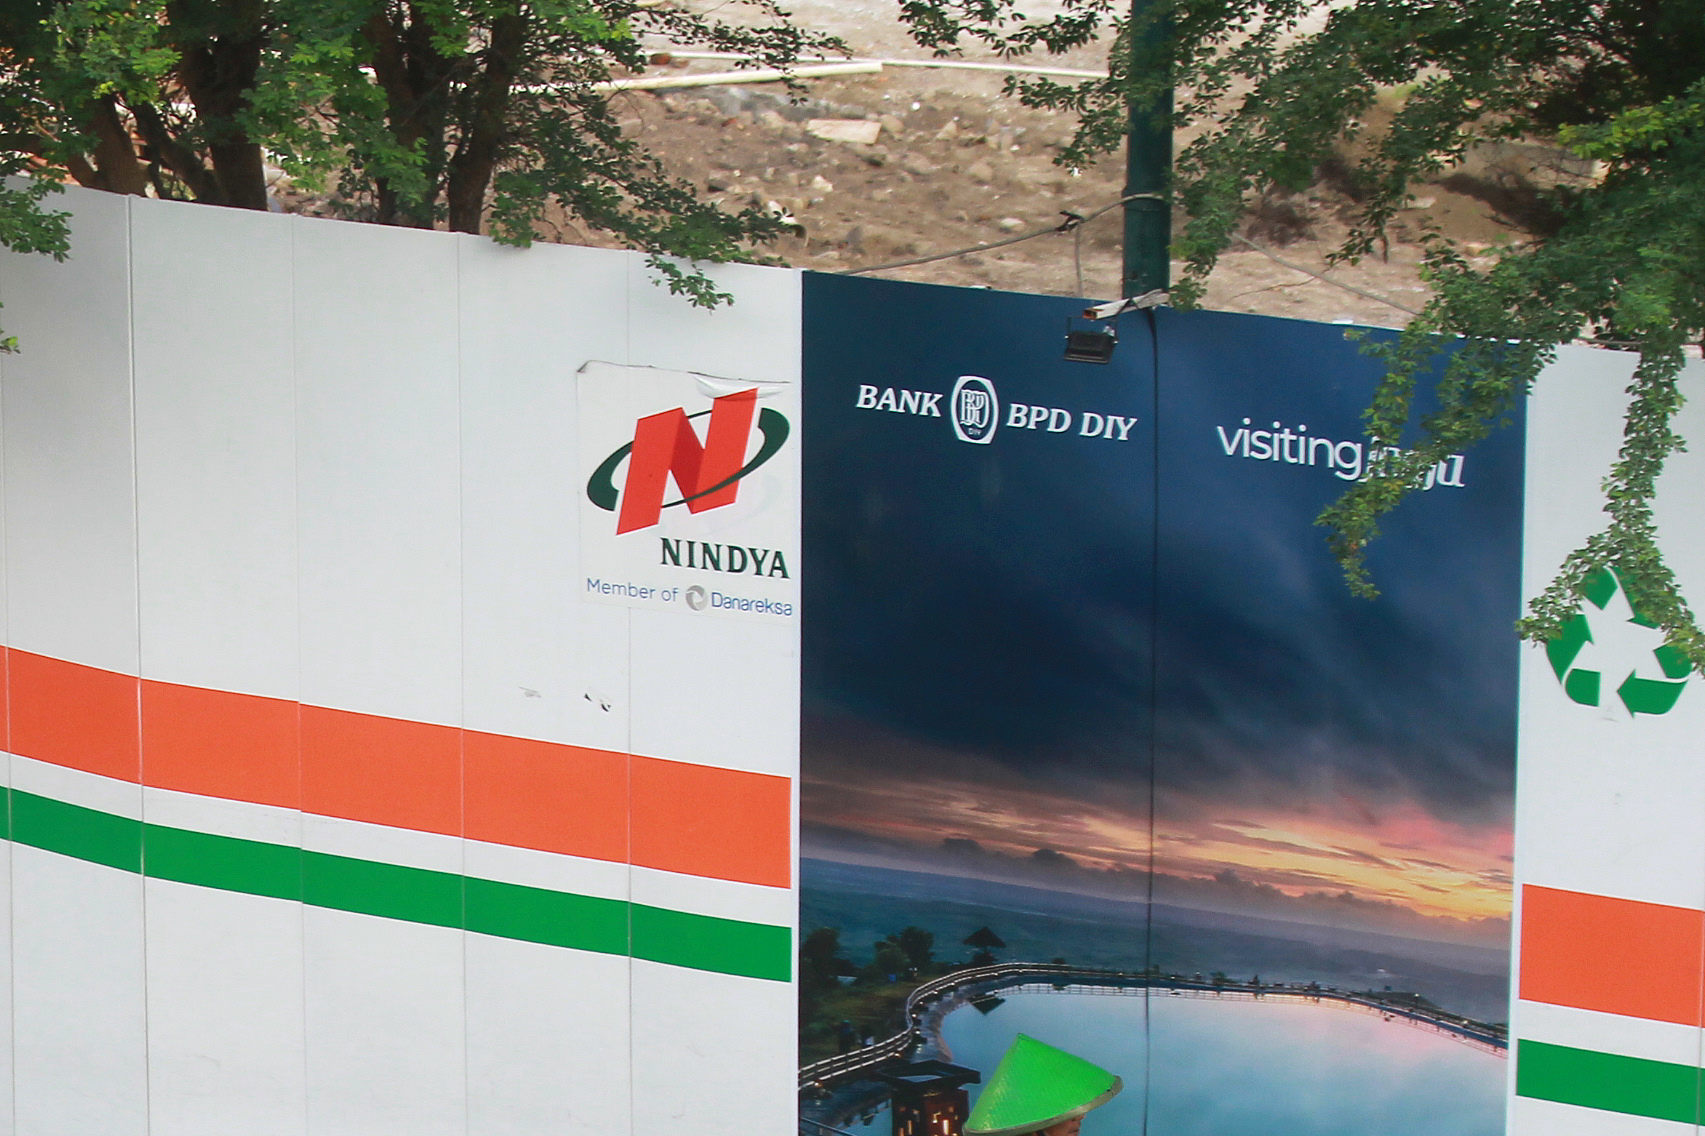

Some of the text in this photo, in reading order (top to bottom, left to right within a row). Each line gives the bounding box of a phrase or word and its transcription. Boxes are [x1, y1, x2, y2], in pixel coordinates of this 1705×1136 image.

[856, 384, 1138, 441] BANK BPD DIY
[660, 537, 790, 579] NINDYA
[587, 578, 793, 617] Member of Danareksa
